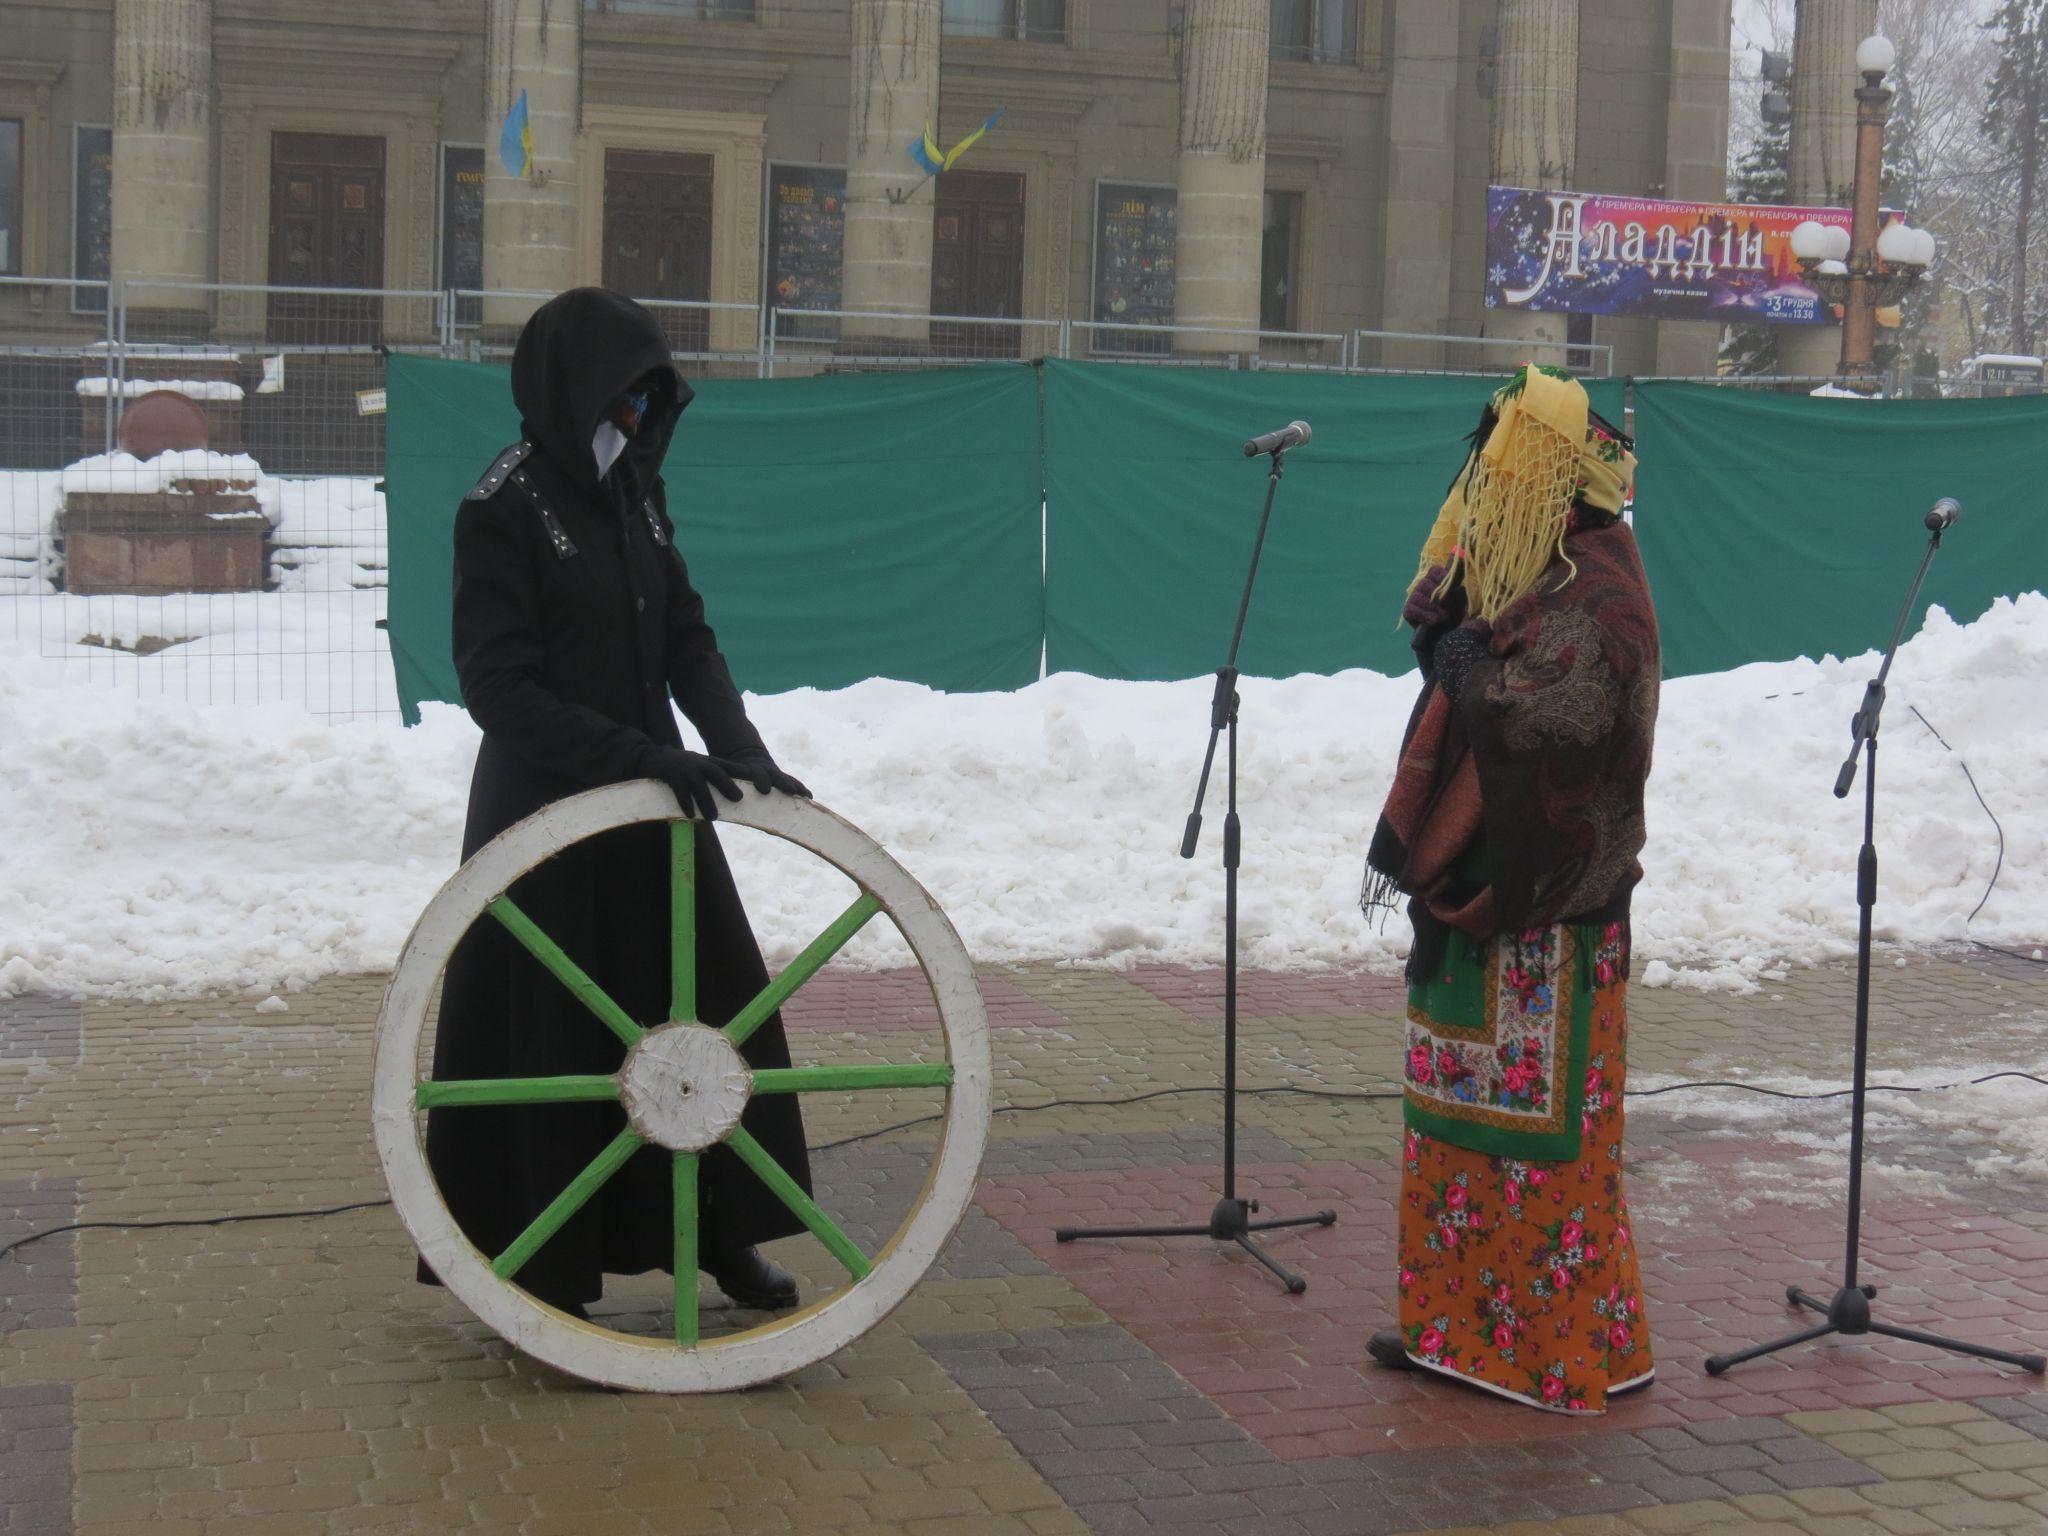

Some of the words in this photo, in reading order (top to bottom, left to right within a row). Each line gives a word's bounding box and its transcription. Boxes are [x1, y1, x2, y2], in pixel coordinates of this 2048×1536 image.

[1506, 197, 1764, 302] Аладдін
[1783, 298, 1814, 309] ГРУДНЯ
[1793, 309, 1814, 320] 13.30
